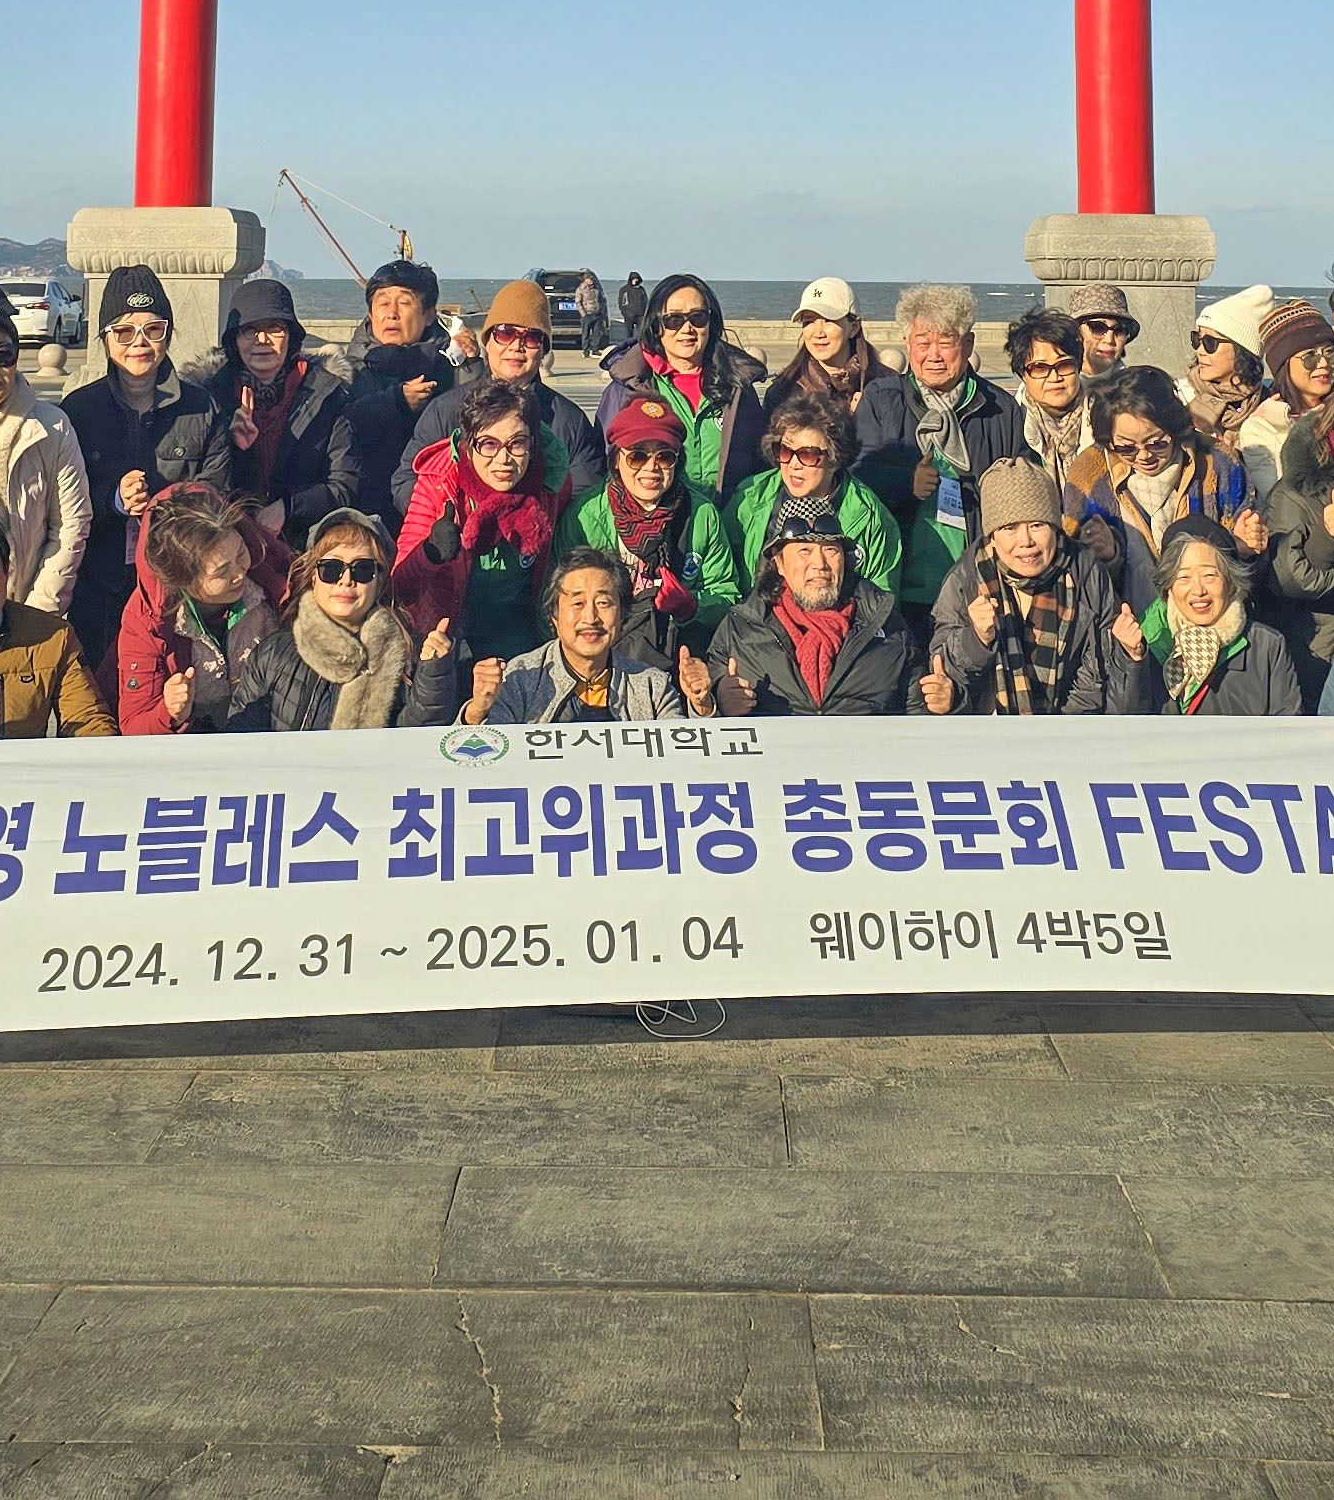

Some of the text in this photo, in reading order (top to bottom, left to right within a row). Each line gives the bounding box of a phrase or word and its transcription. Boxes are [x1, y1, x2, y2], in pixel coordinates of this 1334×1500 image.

[524, 726, 764, 760] 한서대학교
[53, 791, 360, 895] 노블레스
[387, 780, 759, 882] 최고위과정
[782, 779, 1078, 873] 총동문회
[37, 942, 179, 993] 2024.
[207, 937, 277, 982] 12.
[299, 933, 353, 977] 31
[426, 923, 565, 971] 2025.
[586, 920, 661, 964] 01.
[682, 916, 744, 961] 04
[809, 909, 999, 961] 웨이하이
[1016, 909, 1172, 960] 4박5일
